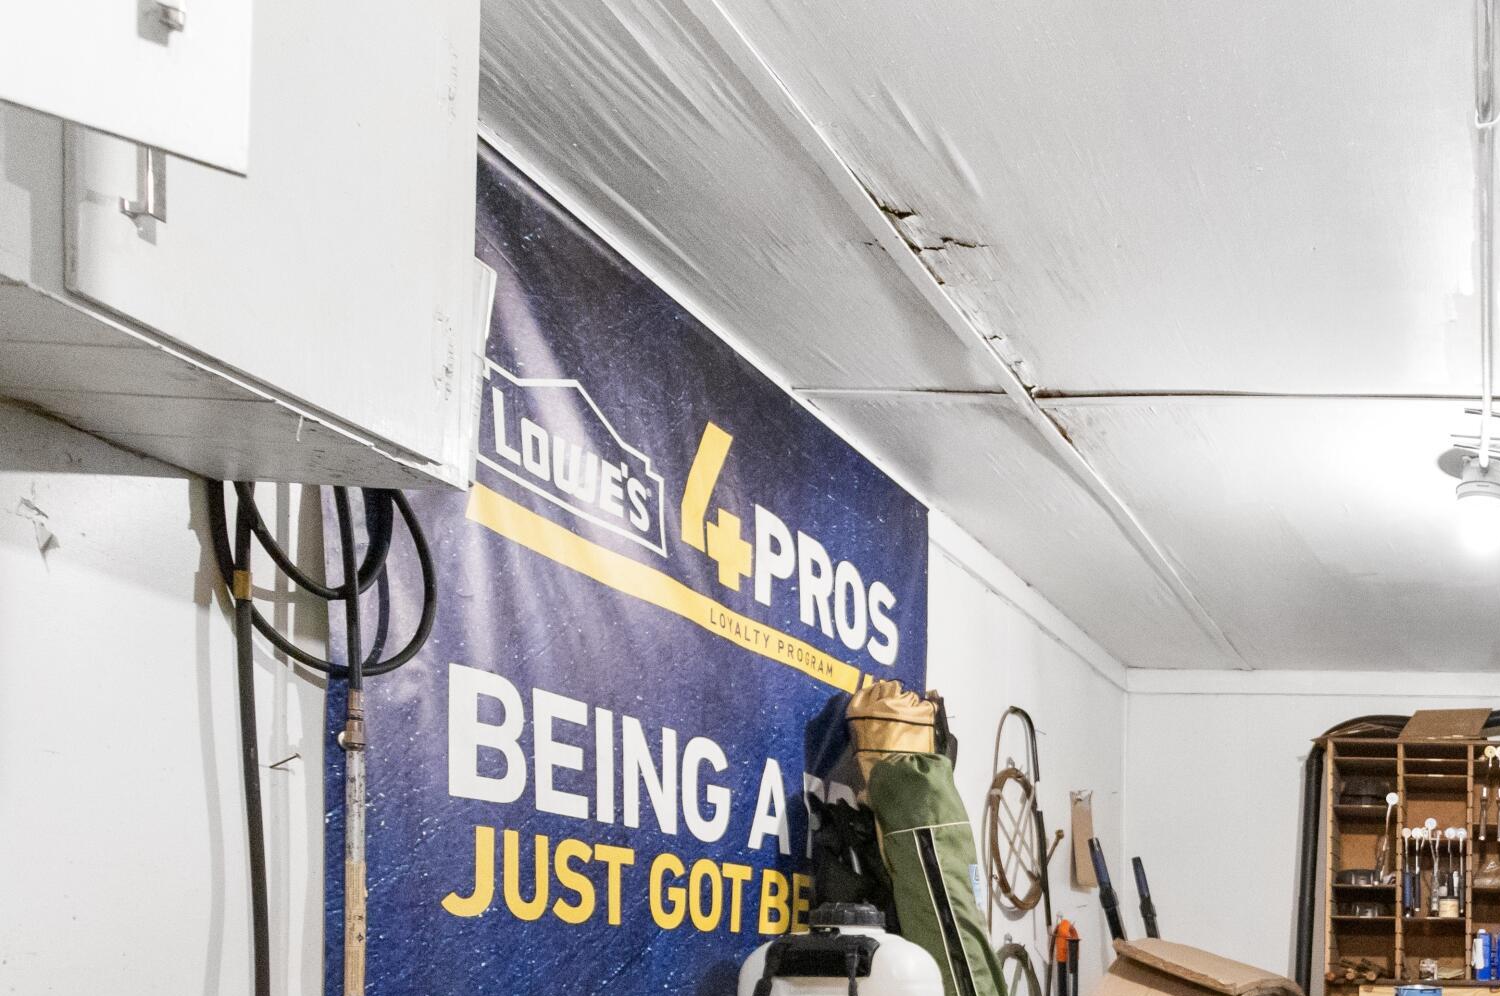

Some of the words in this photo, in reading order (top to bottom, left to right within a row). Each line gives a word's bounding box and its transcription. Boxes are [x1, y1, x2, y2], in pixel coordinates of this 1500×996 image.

[492, 387, 651, 533] LOWE'S
[680, 421, 752, 590] 4
[755, 504, 899, 666] PROS
[709, 606, 770, 649] LOYALTY
[777, 638, 834, 678] PROGRAM
[449, 663, 731, 843] BEING
[747, 757, 791, 856] A
[441, 825, 635, 926] JUST
[649, 853, 752, 934] GOT
